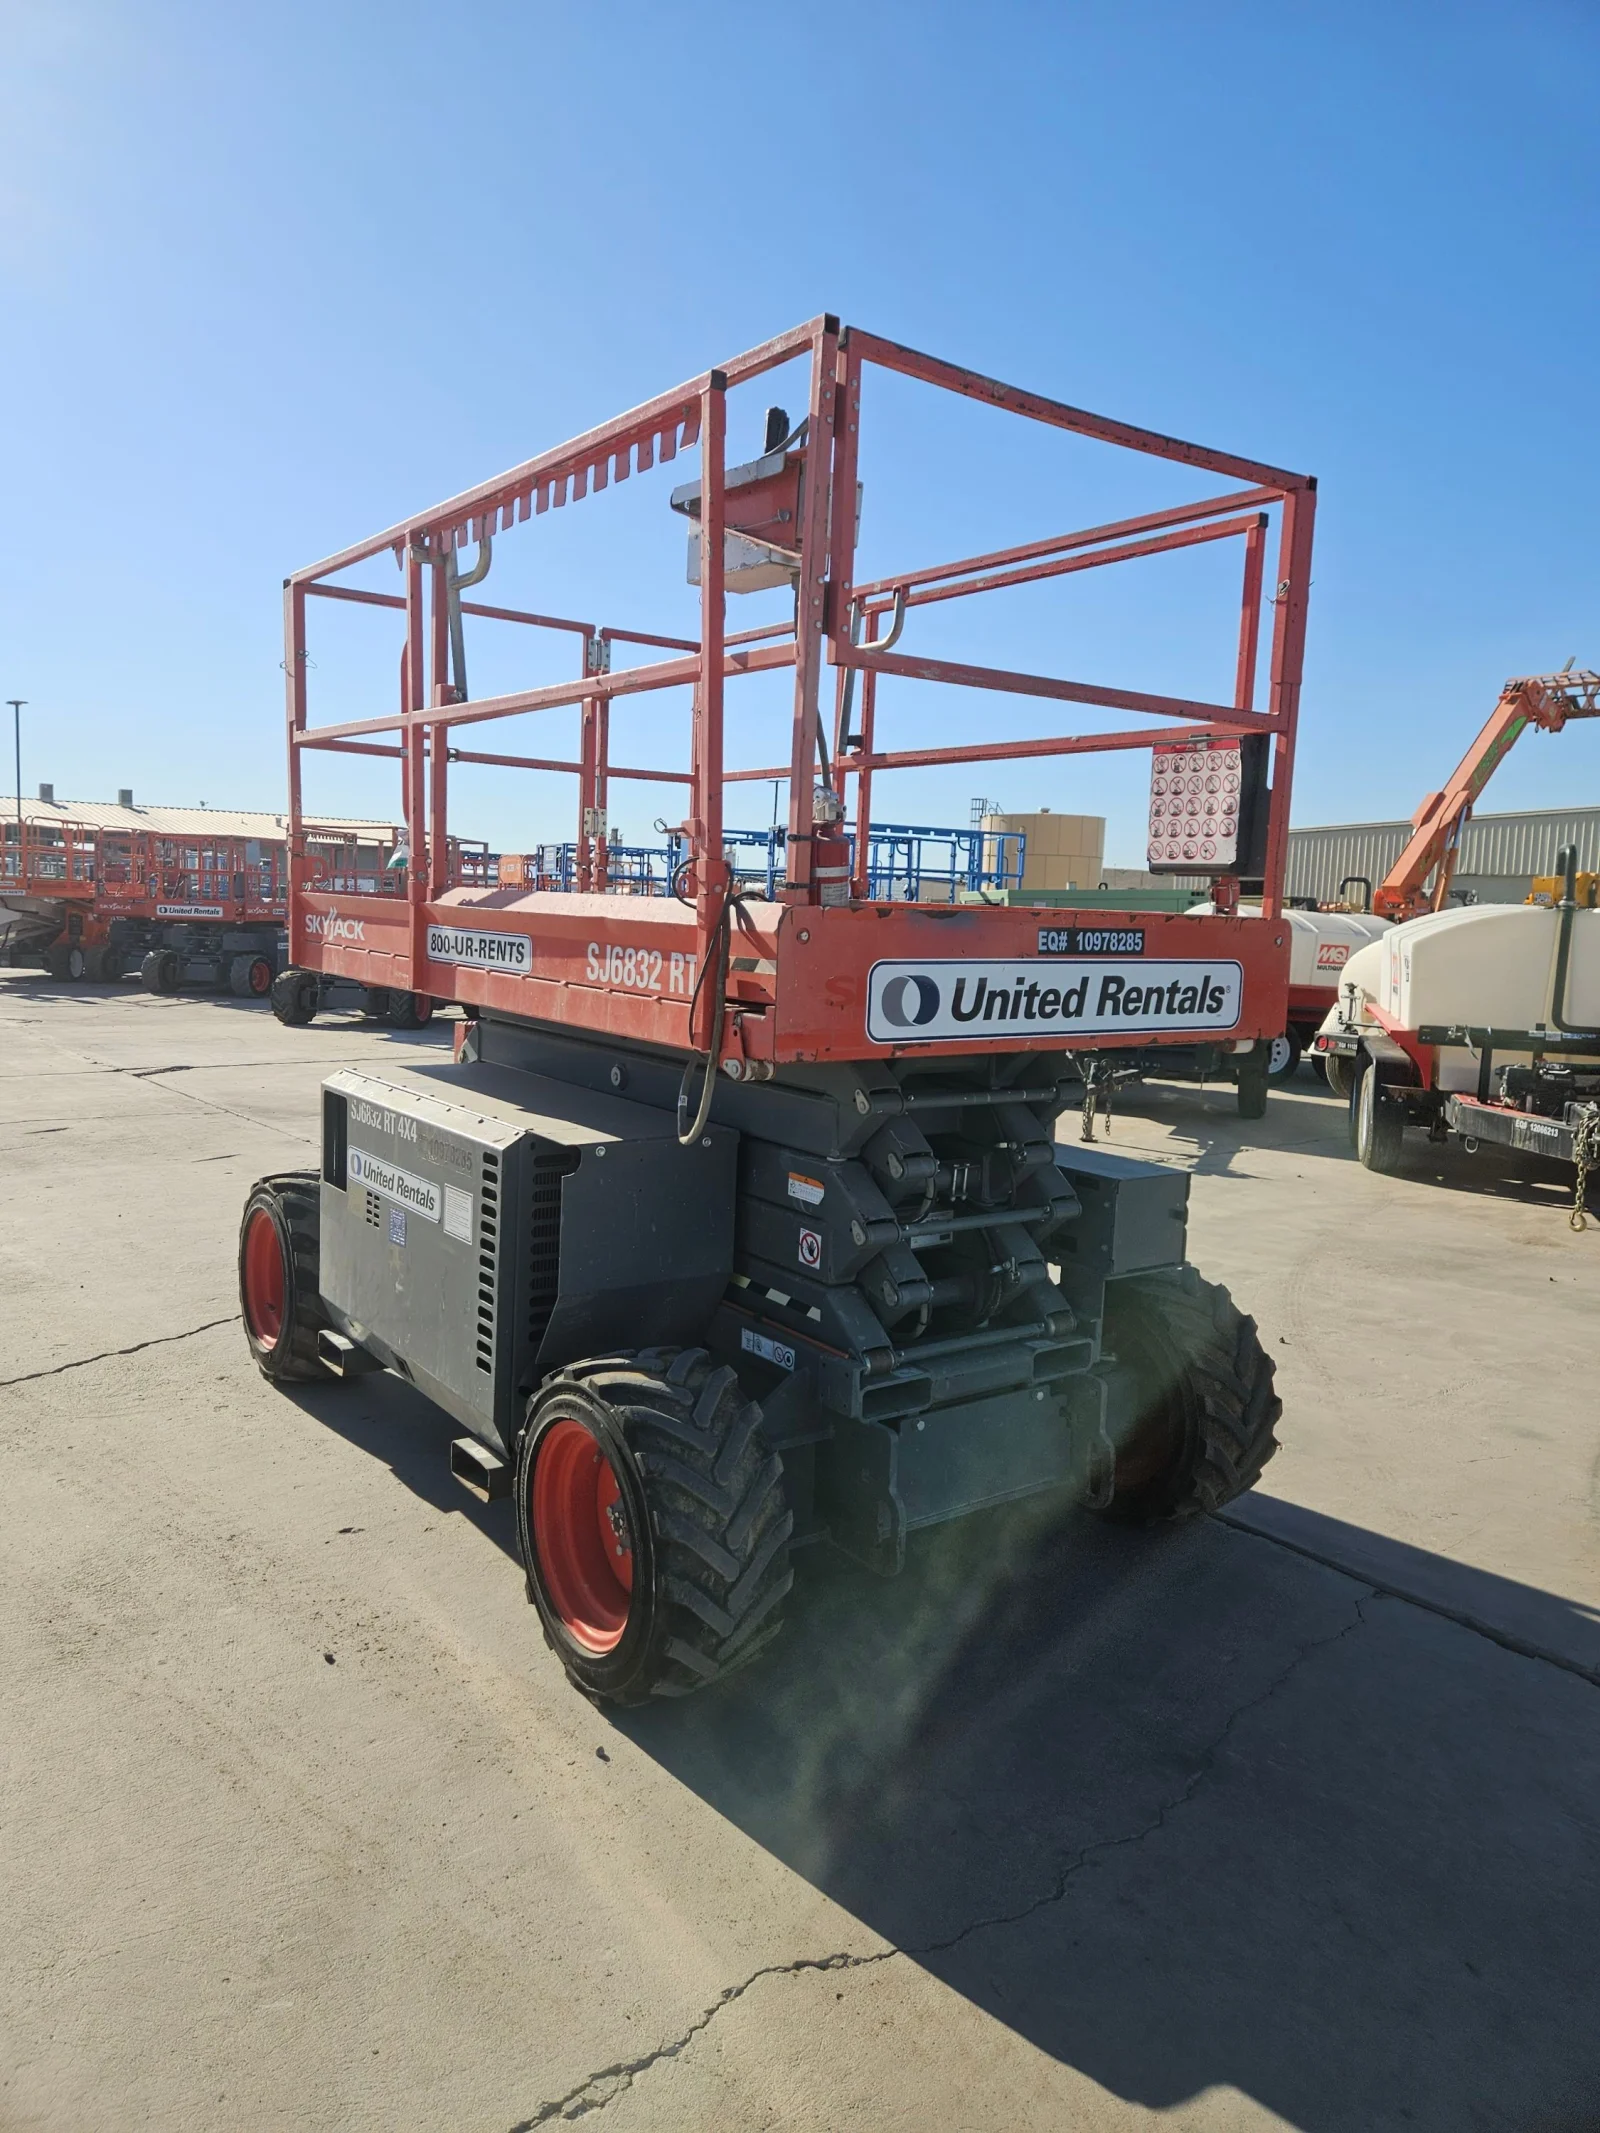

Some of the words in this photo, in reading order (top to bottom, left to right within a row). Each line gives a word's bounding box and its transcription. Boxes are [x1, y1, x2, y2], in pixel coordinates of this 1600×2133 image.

[194, 907, 220, 915] Rentals
[305, 906, 366, 941] SKYJACK
[430, 932, 525, 964] 800-UR-RENTS
[1038, 931, 1068, 951] EQ#
[1076, 931, 1143, 951] 10978285
[1318, 945, 1348, 964] MQ
[586, 942, 662, 991] SJ6832
[669, 952, 697, 995] RT
[950, 976, 1090, 1022] United
[351, 1099, 382, 1130] SJ6832
[383, 1109, 397, 1135] RT
[398, 1115, 417, 1143] 4X4
[363, 1160, 395, 1192] United
[396, 1175, 435, 1212] Rentals
